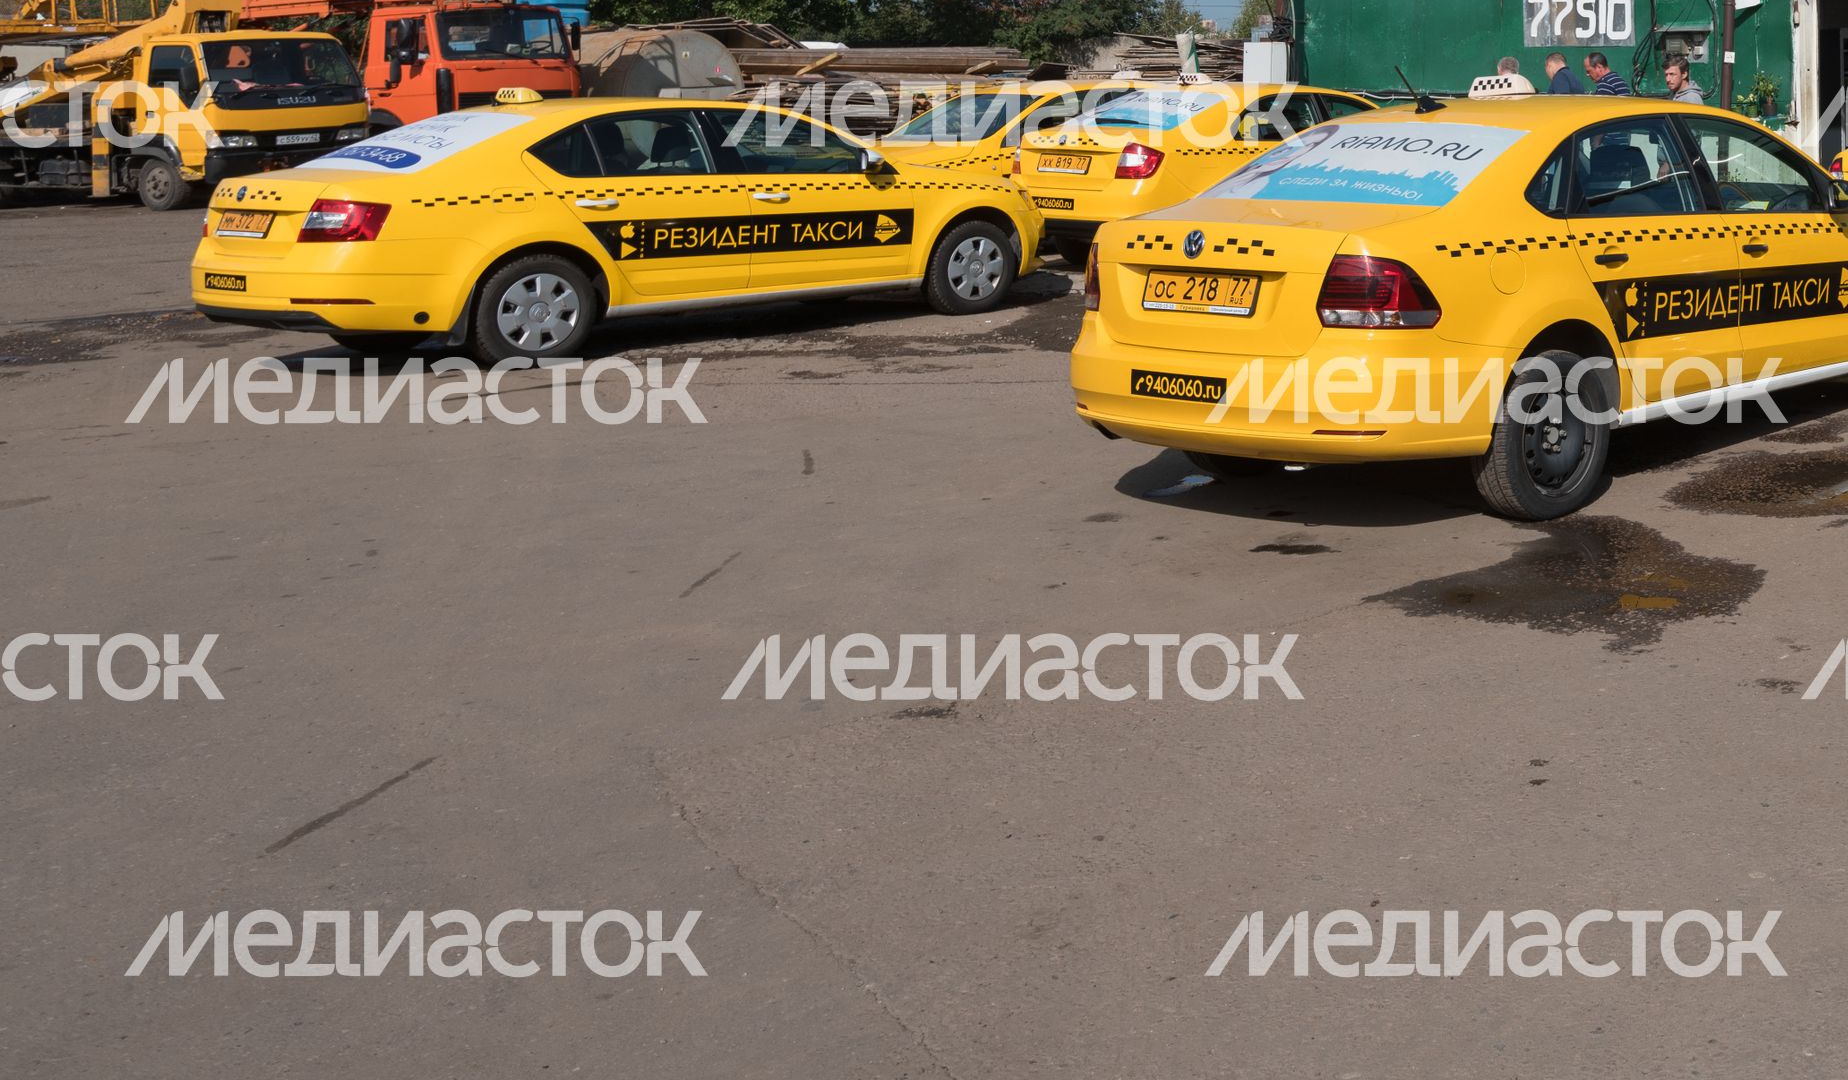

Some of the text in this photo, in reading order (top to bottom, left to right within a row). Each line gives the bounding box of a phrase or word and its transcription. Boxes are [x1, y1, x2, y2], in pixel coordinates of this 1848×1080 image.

[277, 95, 317, 105] ISUZU
[1056, 156, 1072, 168] 819
[1278, 176, 1423, 201] СЛЕДИ ЗА ЖИЗНЬЮ!
[653, 224, 780, 249] РЕЗИДЕНТ
[791, 221, 863, 243] ТАКСИ
[1183, 276, 1219, 301] 218
[1230, 277, 1251, 297] 77
[1229, 296, 1244, 305] RUS
[1654, 278, 1831, 322] РЕЗИДЕНТ ТАКСИ
[1146, 375, 1221, 400] 9406060.ru
